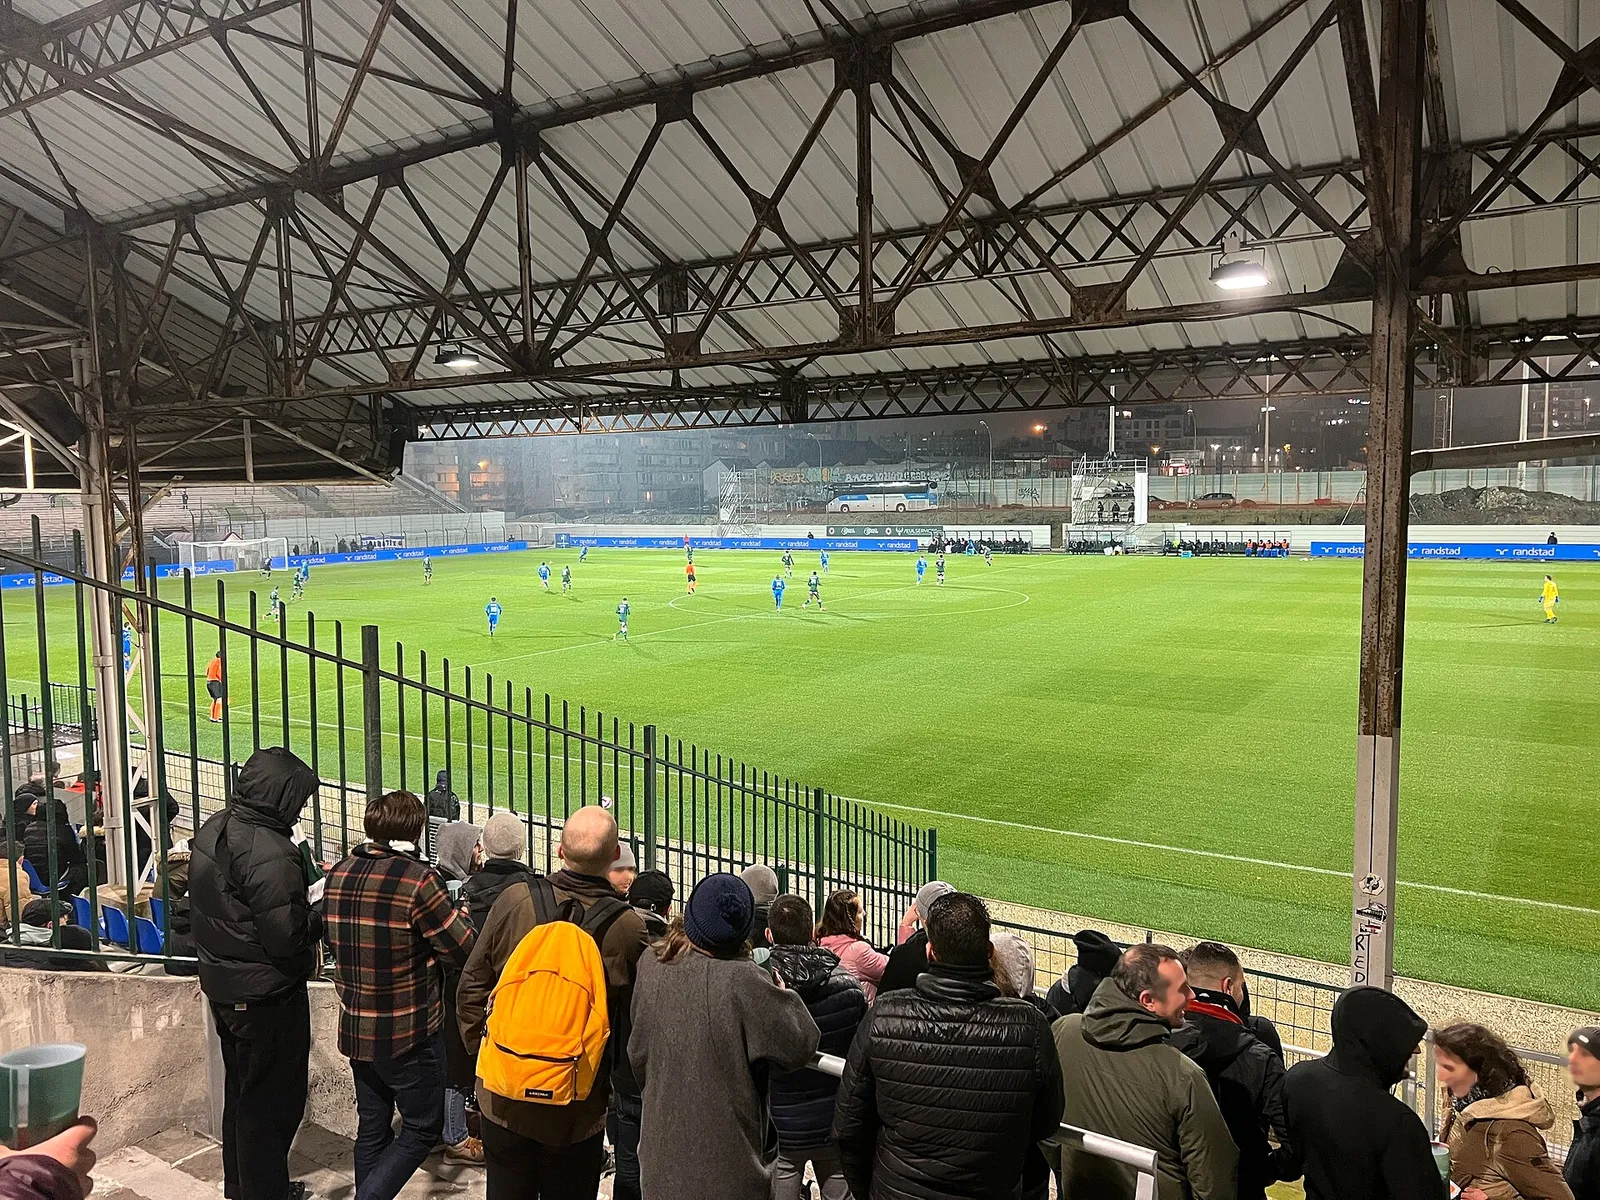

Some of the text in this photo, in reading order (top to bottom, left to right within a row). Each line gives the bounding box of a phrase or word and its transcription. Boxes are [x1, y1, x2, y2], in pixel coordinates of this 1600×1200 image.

[702, 539, 722, 547] randstad
[787, 540, 809, 548] randstad
[835, 540, 858, 548] randstad
[886, 541, 911, 549] randstad
[1336, 546, 1365, 554] randsta
[1421, 546, 1461, 555] randstad
[1512, 547, 1555, 556] randstad
[354, 553, 377, 561] randstad
[28, 575, 63, 585] radstad
